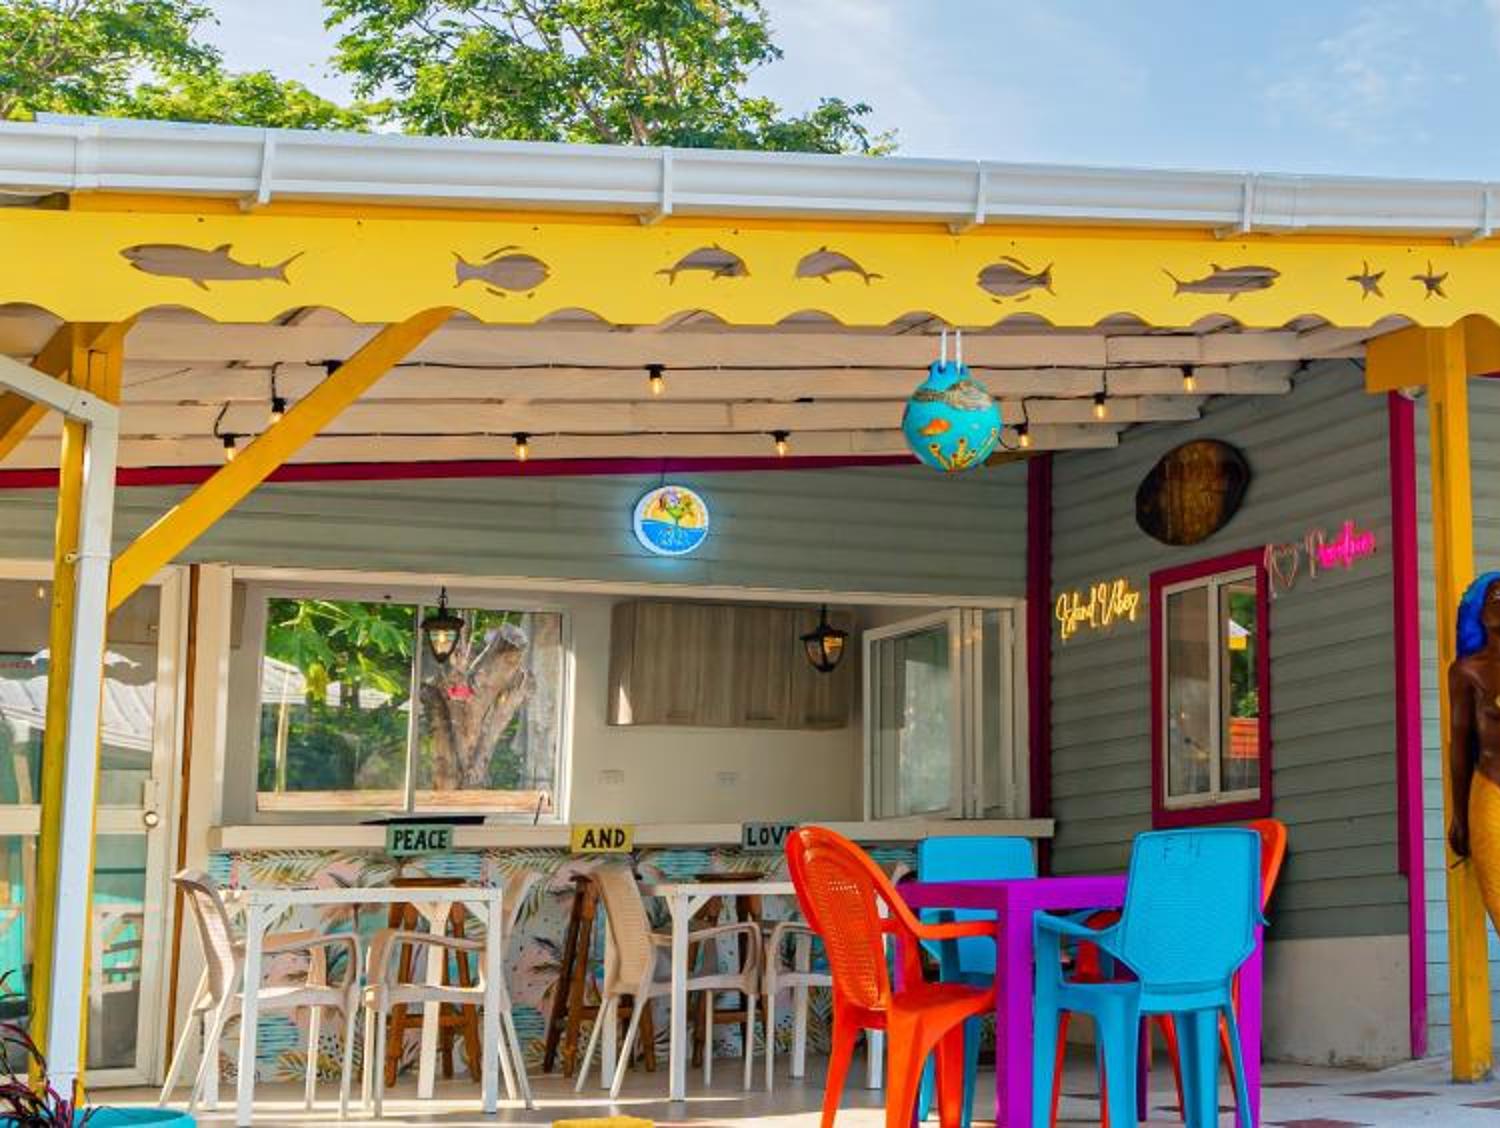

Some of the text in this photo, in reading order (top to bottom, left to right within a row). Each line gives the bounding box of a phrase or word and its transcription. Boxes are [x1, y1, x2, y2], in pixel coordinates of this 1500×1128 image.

[393, 829, 449, 850] PEACE
[581, 828, 625, 848] AND
[747, 825, 796, 847] LOV
